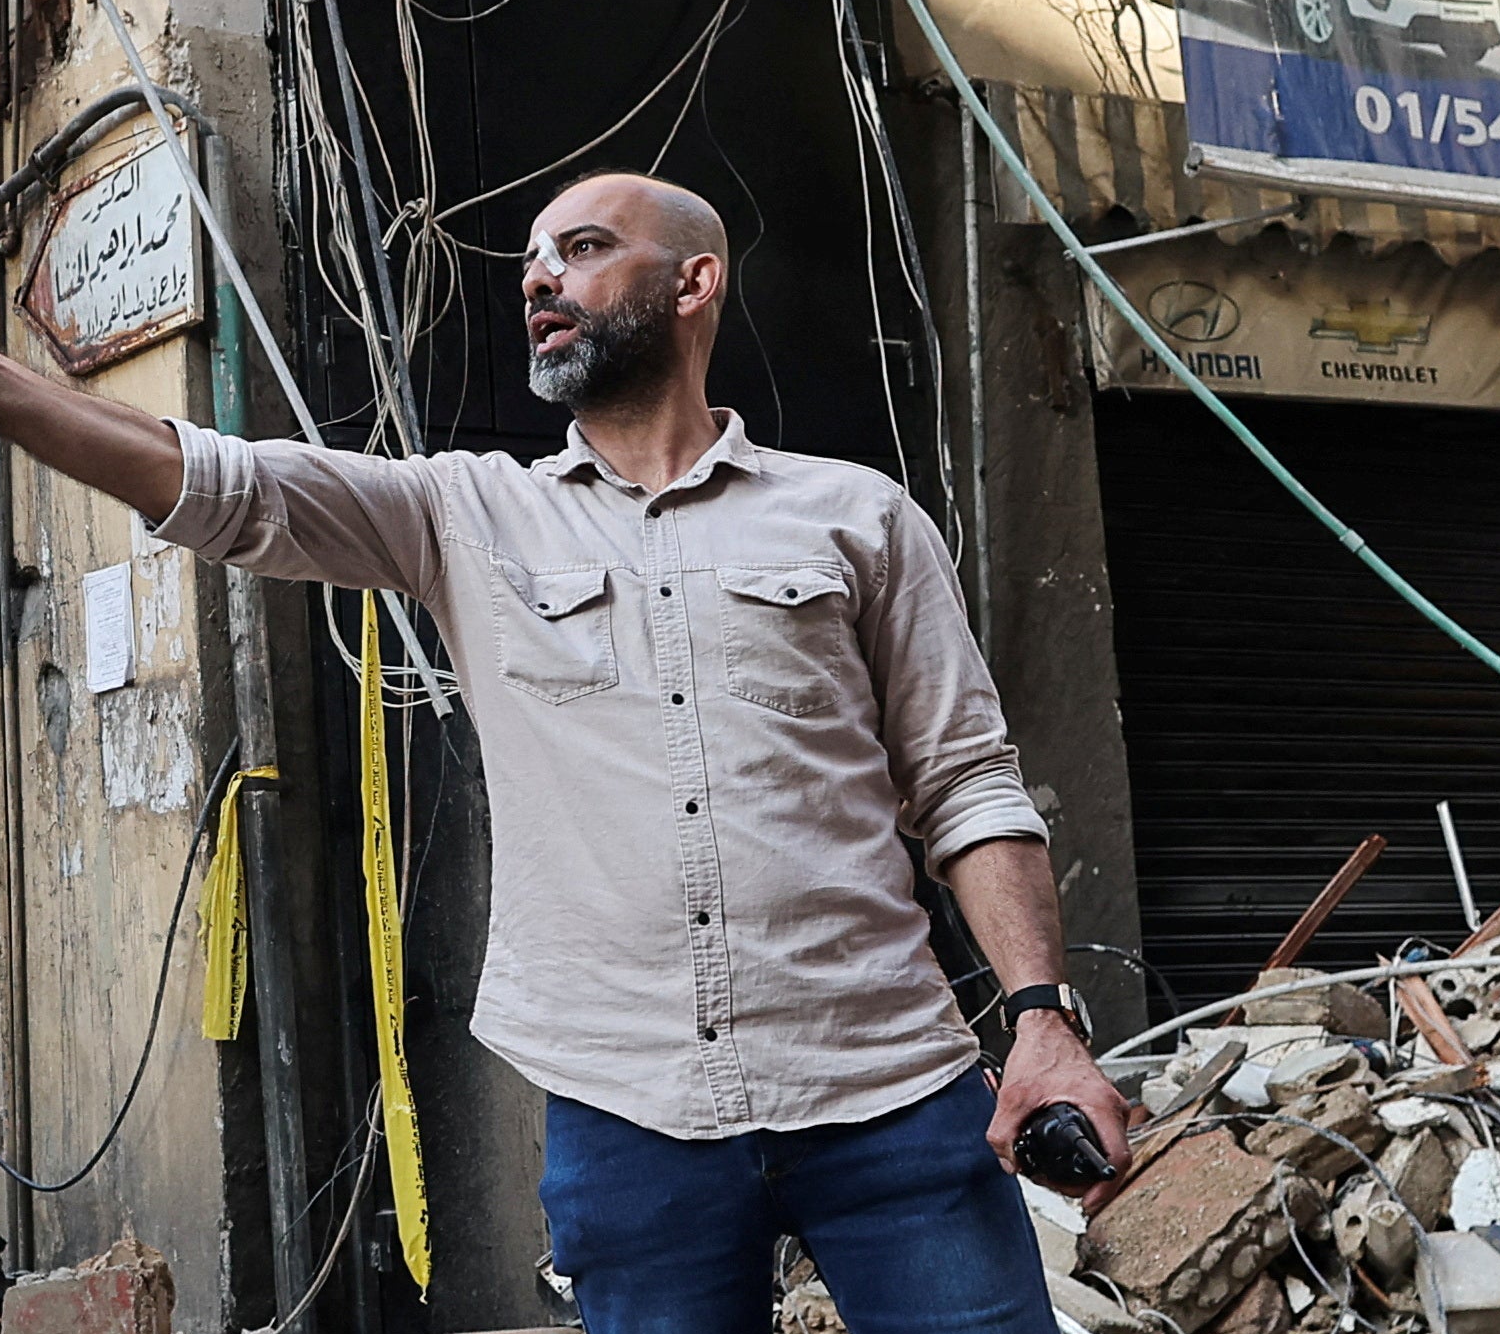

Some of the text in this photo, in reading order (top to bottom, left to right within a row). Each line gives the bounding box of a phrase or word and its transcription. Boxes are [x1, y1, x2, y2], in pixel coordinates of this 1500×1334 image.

[81, 159, 141, 224] الدكتور
[1141, 348, 1262, 380] HUNDAI
[1321, 360, 1440, 385] CHEVROLET
